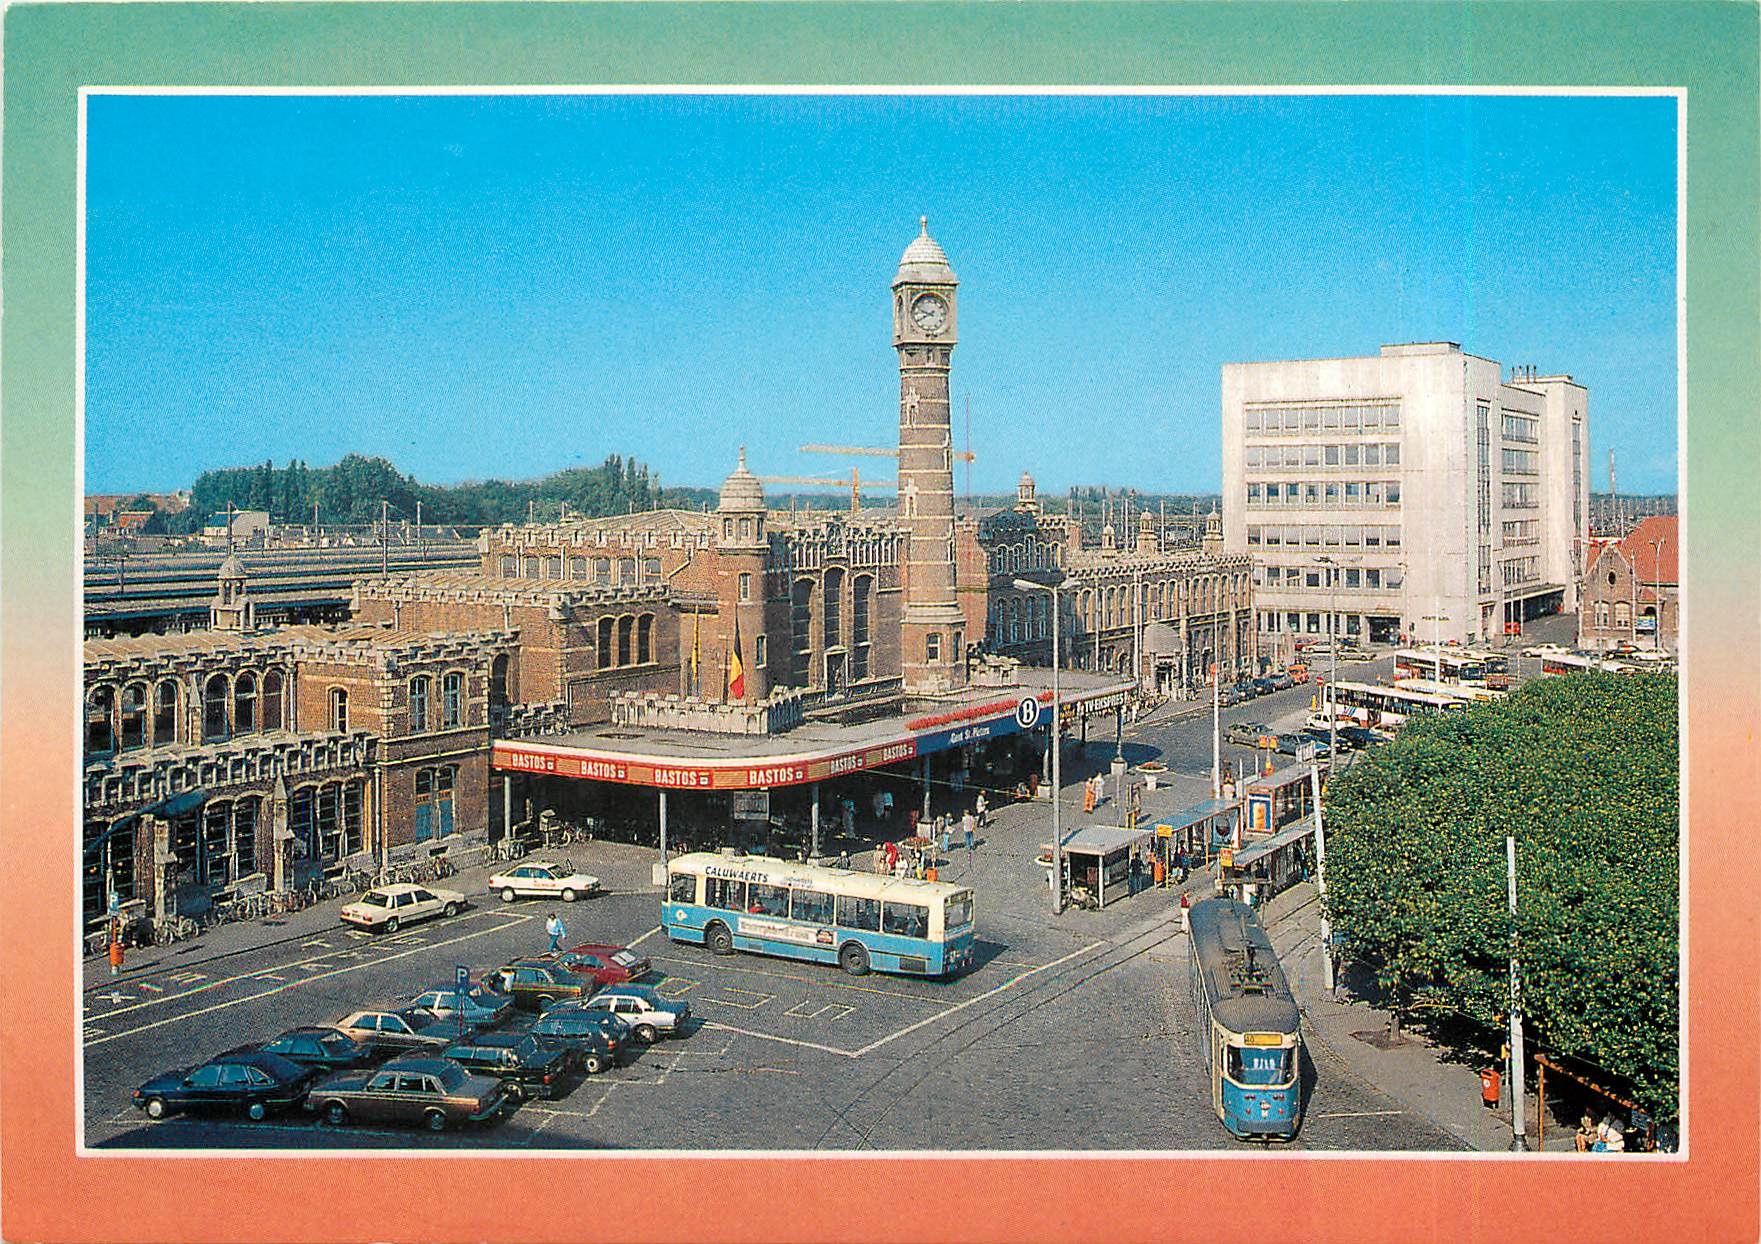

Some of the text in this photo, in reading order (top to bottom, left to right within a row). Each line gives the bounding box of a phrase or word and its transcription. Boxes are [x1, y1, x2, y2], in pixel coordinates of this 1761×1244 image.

[512, 752, 545, 770] BASTOS
[883, 743, 908, 761] BASTOS
[581, 760, 616, 778] BASTOS
[830, 755, 857, 774] BASTOS
[655, 769, 697, 786] BASTOS
[750, 767, 794, 786] BASTOS
[705, 866, 769, 883] CALUWAERTS
[458, 968, 468, 983] P
